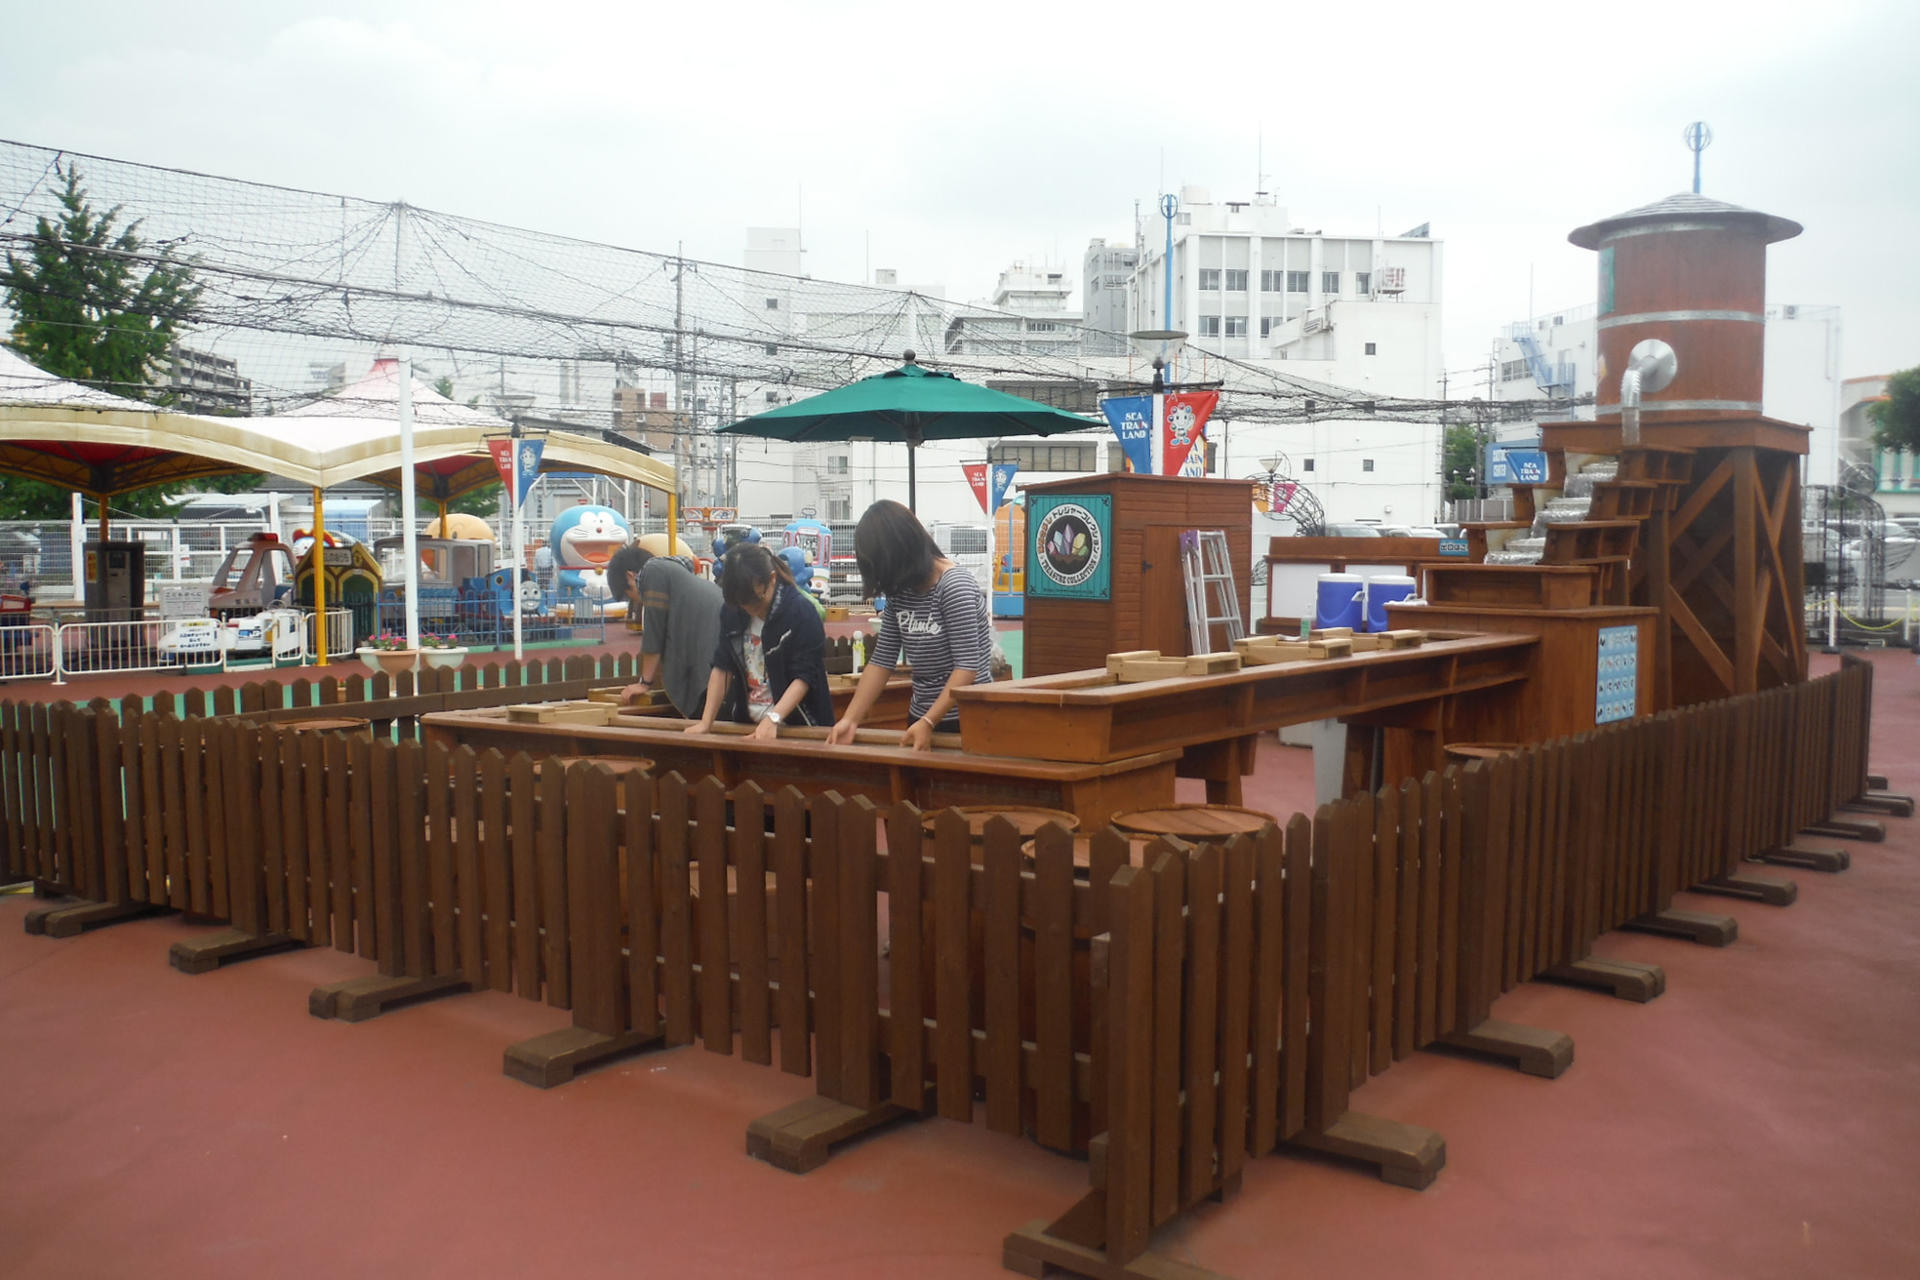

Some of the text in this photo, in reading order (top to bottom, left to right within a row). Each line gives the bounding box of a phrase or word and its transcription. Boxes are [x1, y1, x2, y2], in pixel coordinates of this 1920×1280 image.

[1125, 412, 1143, 421] SEA
[1121, 421, 1148, 430] TRAIN
[1122, 430, 1145, 440] LAND
[1041, 560, 1097, 584] TREASURE COLLECTION
